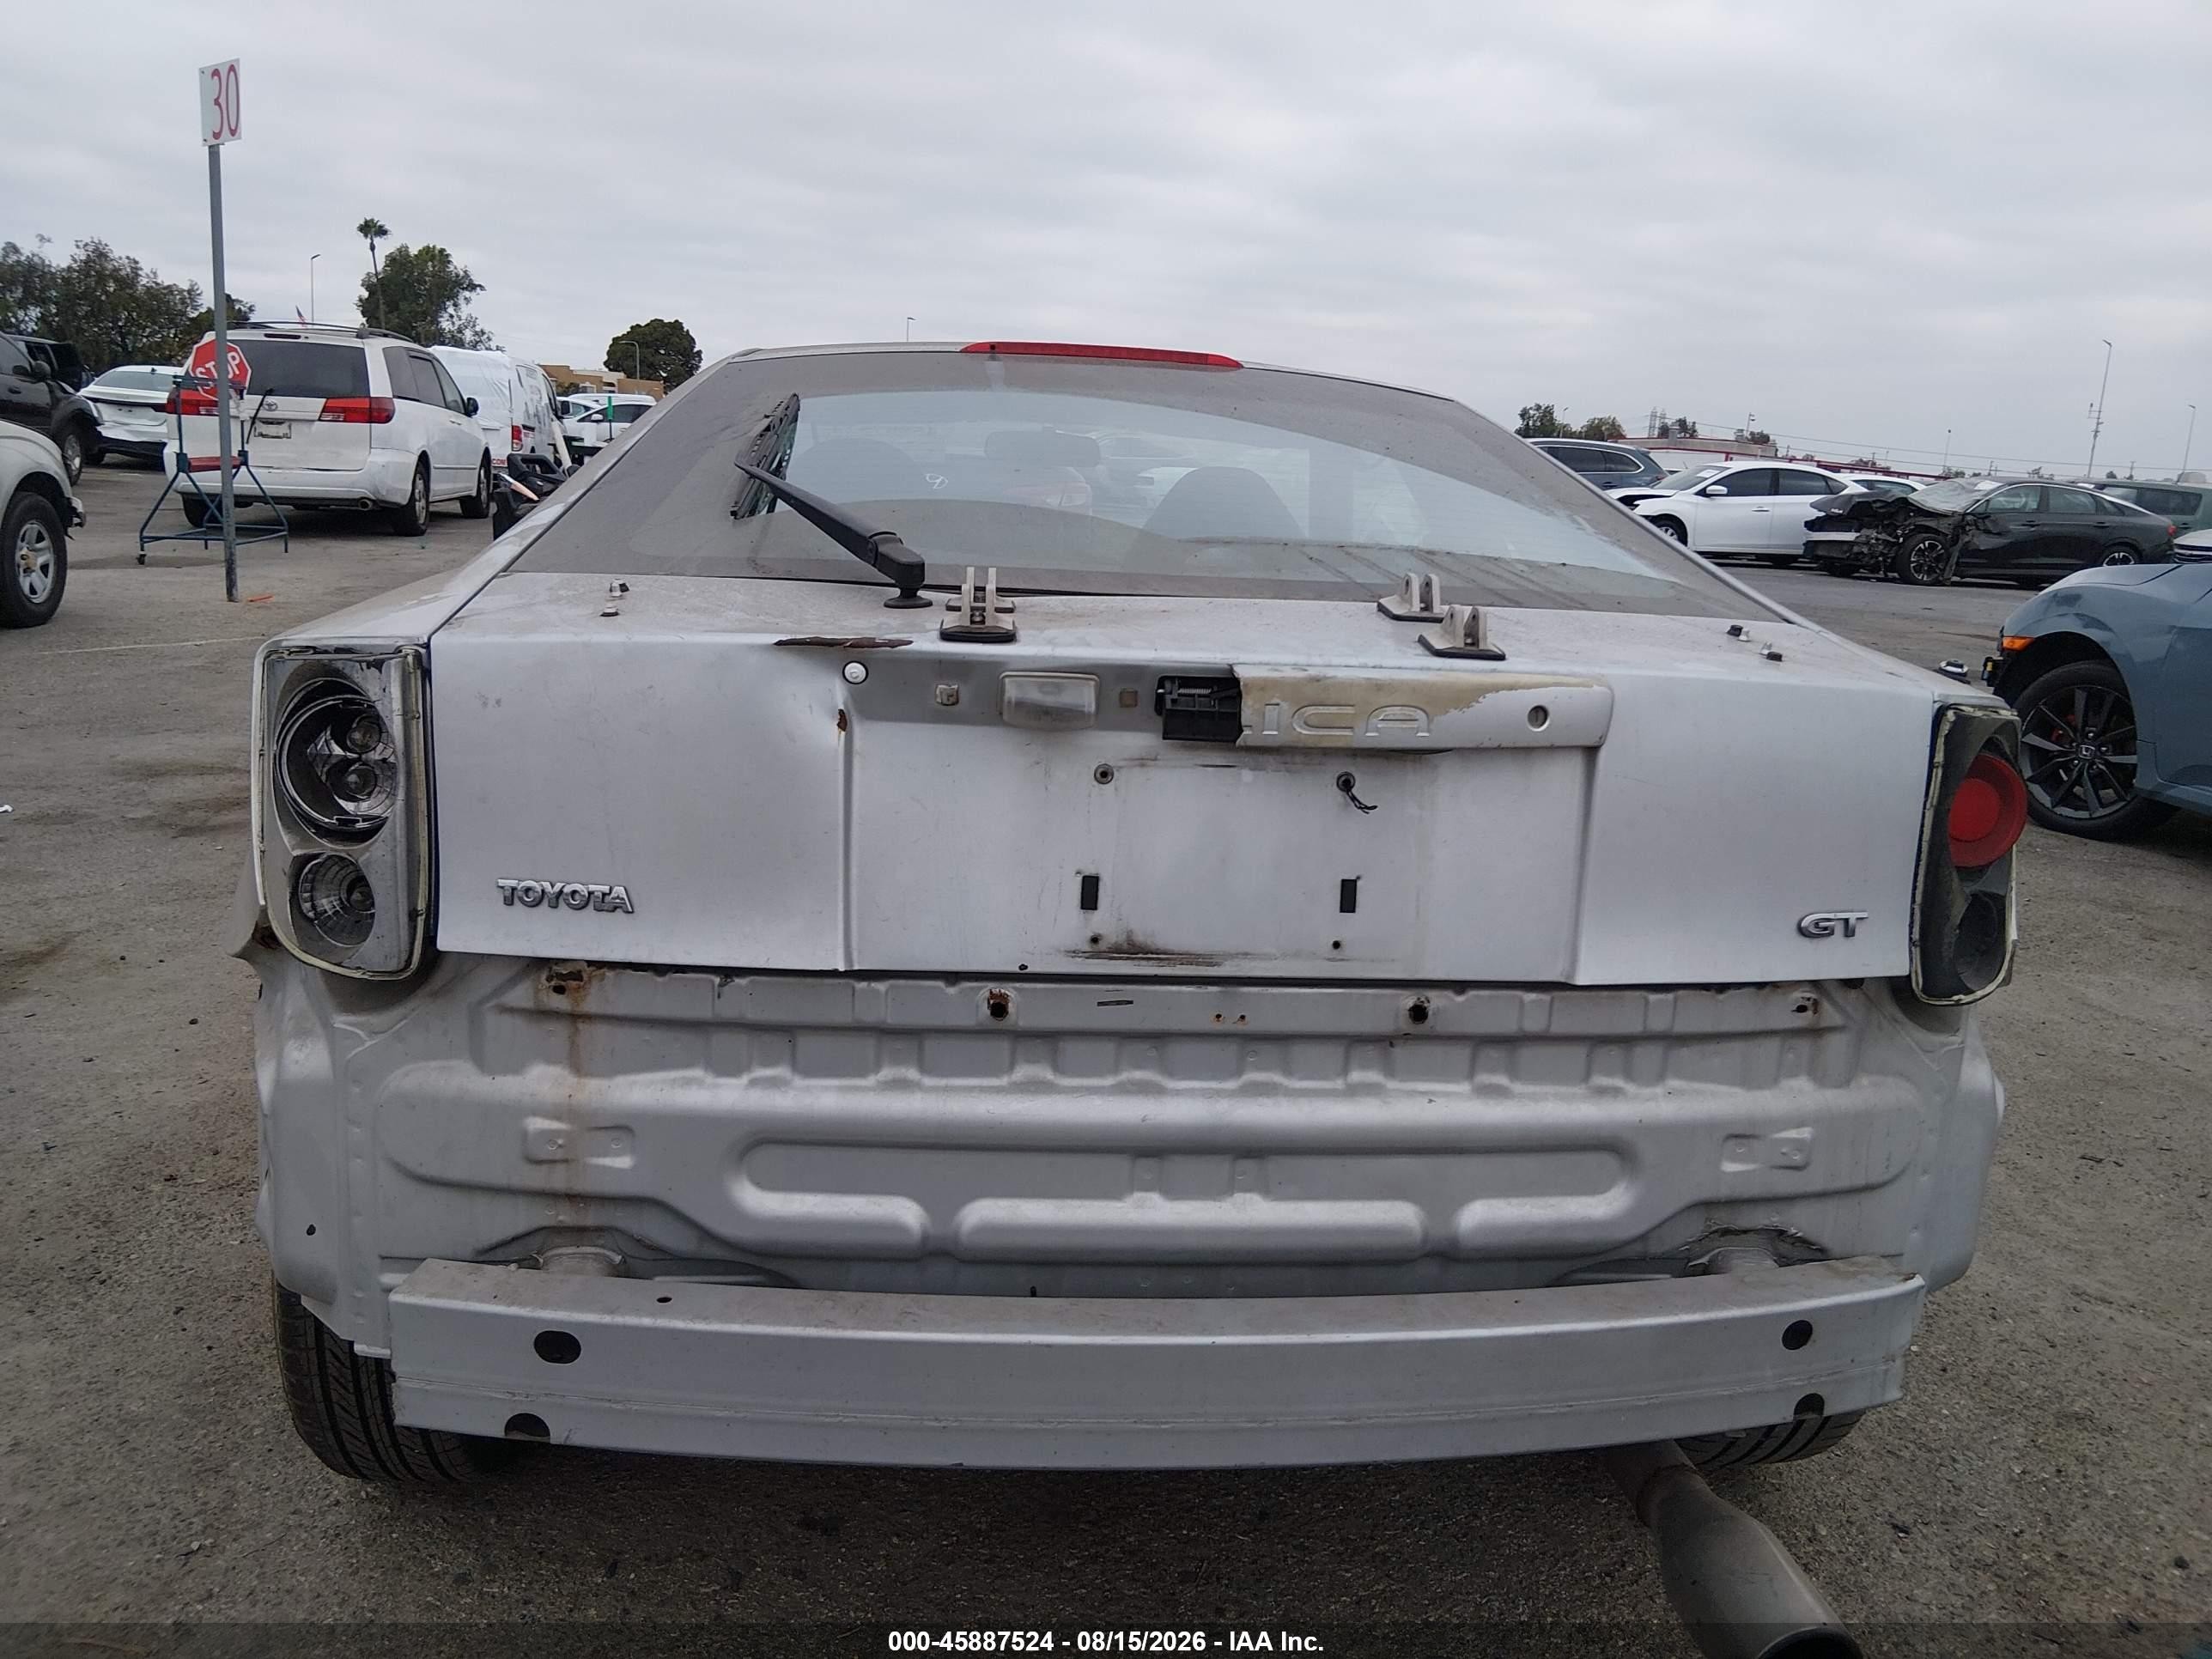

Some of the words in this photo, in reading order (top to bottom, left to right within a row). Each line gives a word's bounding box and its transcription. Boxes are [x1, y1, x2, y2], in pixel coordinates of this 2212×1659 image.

[210, 64, 240, 141] 30
[496, 878, 635, 914] TOYOTA
[1797, 910, 1869, 939] GT
